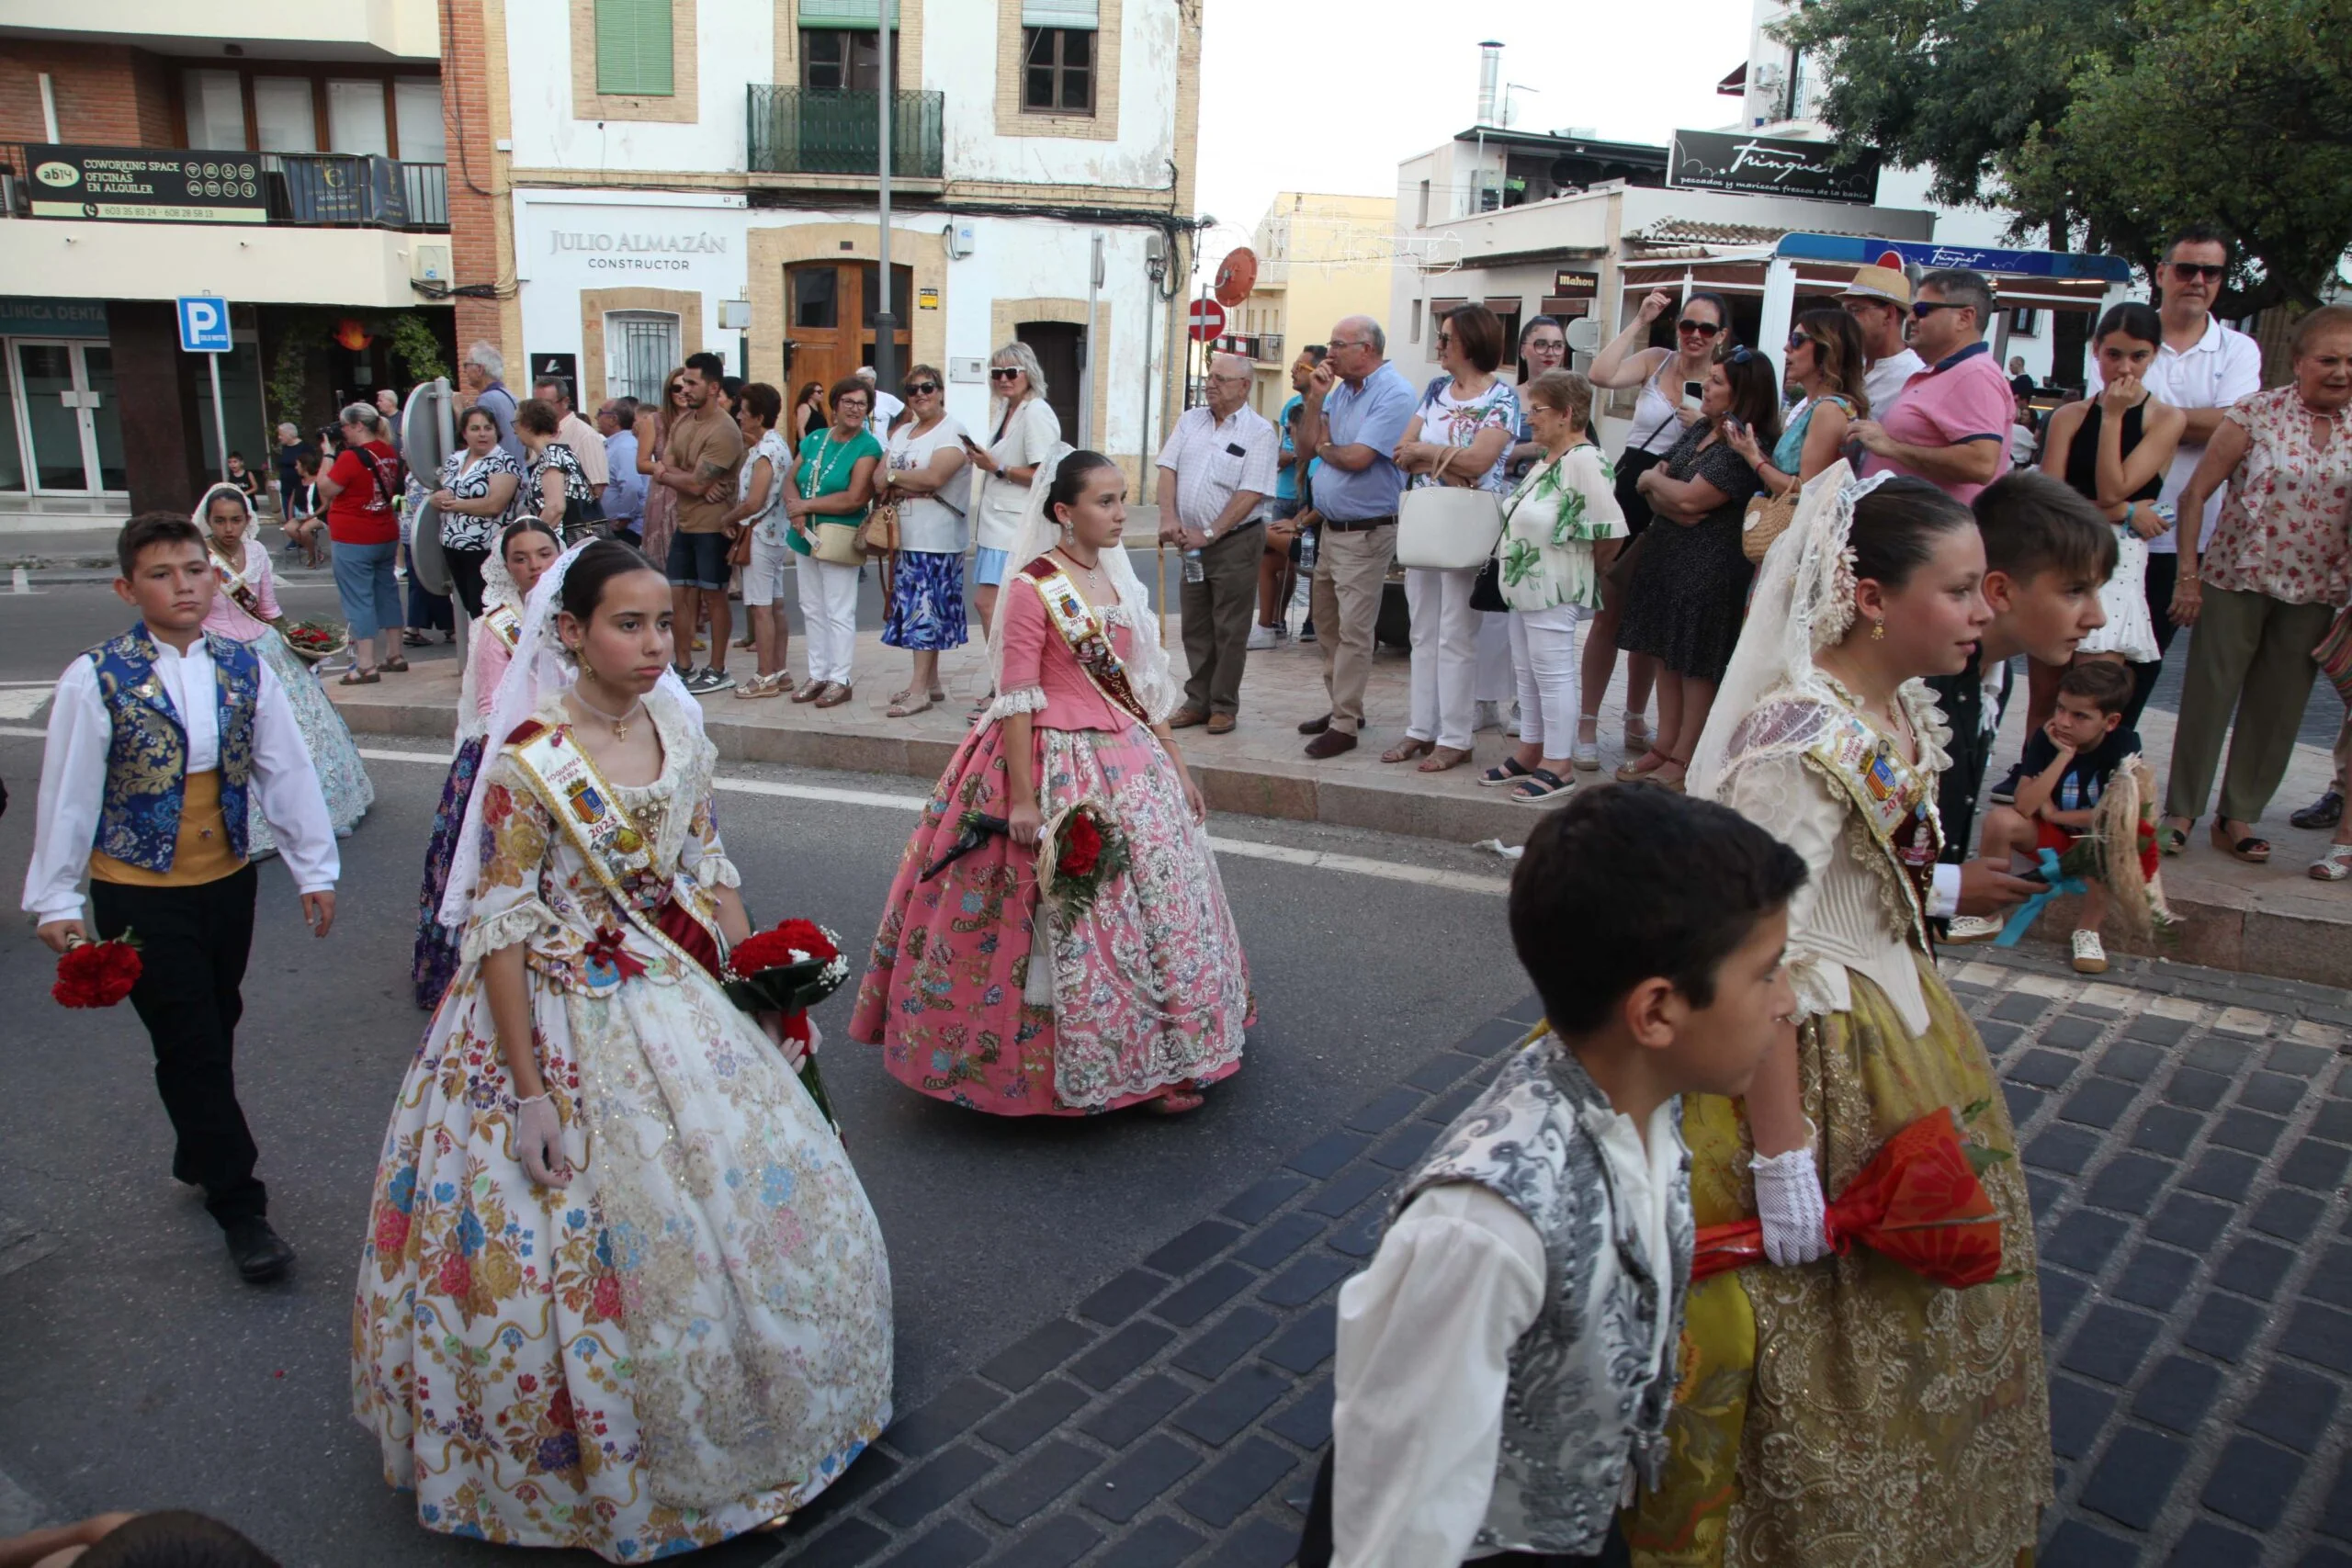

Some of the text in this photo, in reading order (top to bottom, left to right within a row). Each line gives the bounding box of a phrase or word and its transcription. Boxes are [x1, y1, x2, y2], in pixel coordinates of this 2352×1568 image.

[84, 159, 181, 173] COWORKING SPACE
[1730, 139, 1835, 183] Trinque
[85, 172, 134, 183] OFICINAS
[1679, 176, 1724, 186] pescados
[1725, 180, 1734, 189] y
[1736, 181, 1780, 192] mariscos
[1782, 185, 1815, 195] frescos
[86, 183, 154, 194] EN ALQUILER
[105, 207, 120, 216] 603
[123, 207, 133, 216] 35
[147, 208, 156, 217] 24
[205, 209, 214, 219] 13
[550, 230, 728, 255] JULIO ALMAZÁN
[588, 258, 690, 270] CONSTRUCTOR
[1559, 275, 1595, 287] Mahou
[187, 302, 218, 344] P
[547, 756, 582, 783] FOGUERES
[589, 814, 617, 839] 2023
